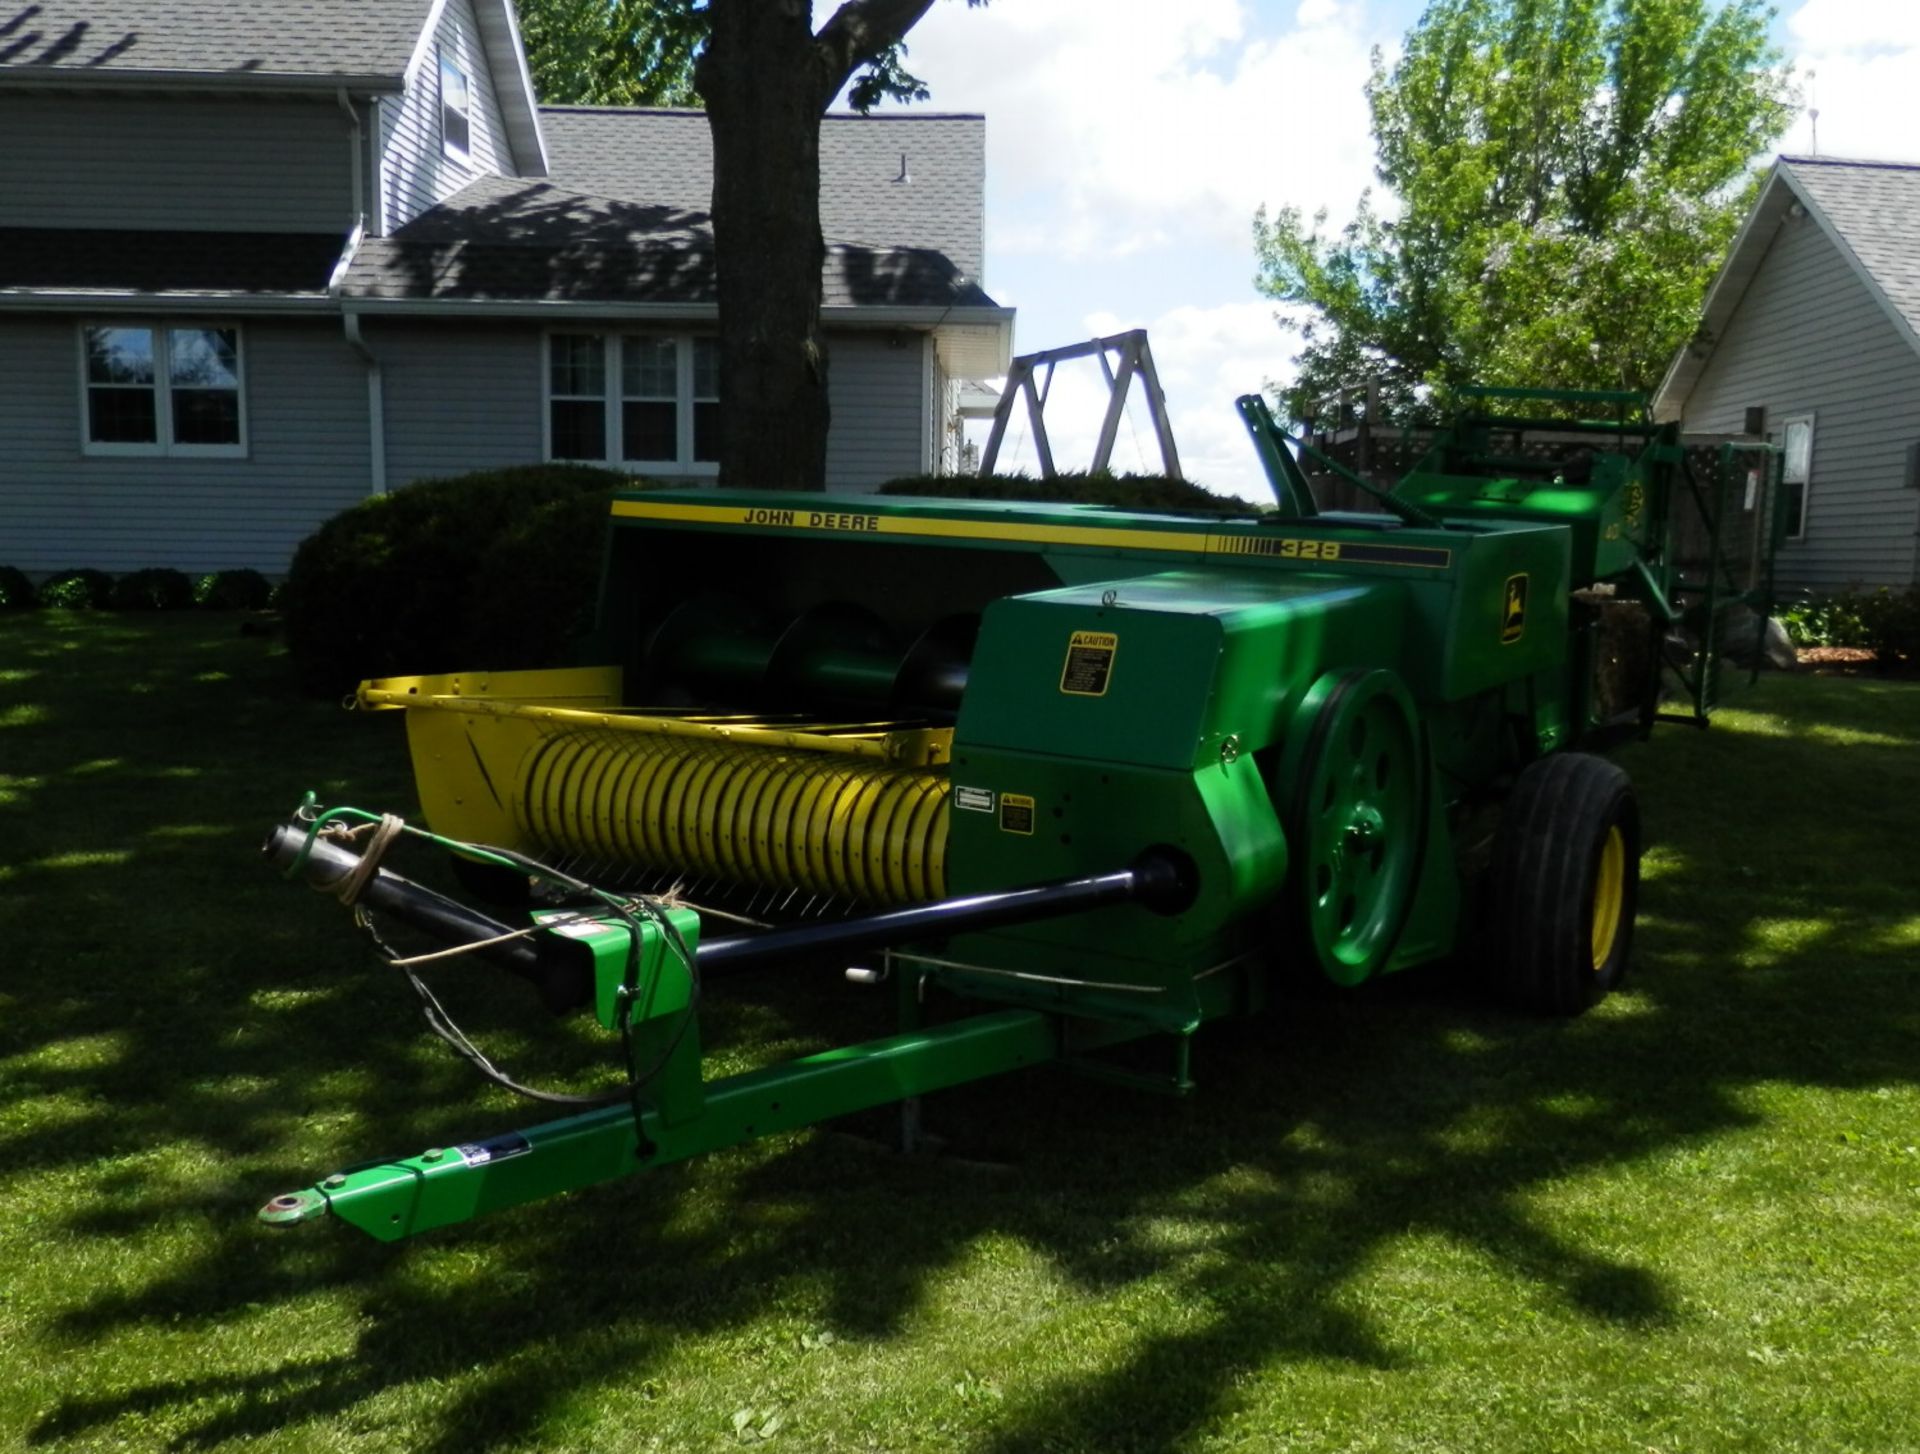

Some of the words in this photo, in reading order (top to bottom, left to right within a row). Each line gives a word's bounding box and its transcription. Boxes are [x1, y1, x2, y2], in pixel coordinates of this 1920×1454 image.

[744, 509, 795, 525] JOHN
[810, 513, 879, 530] DEERE
[1280, 538, 1341, 560] 328
[1083, 635, 1115, 647] CAUTION
